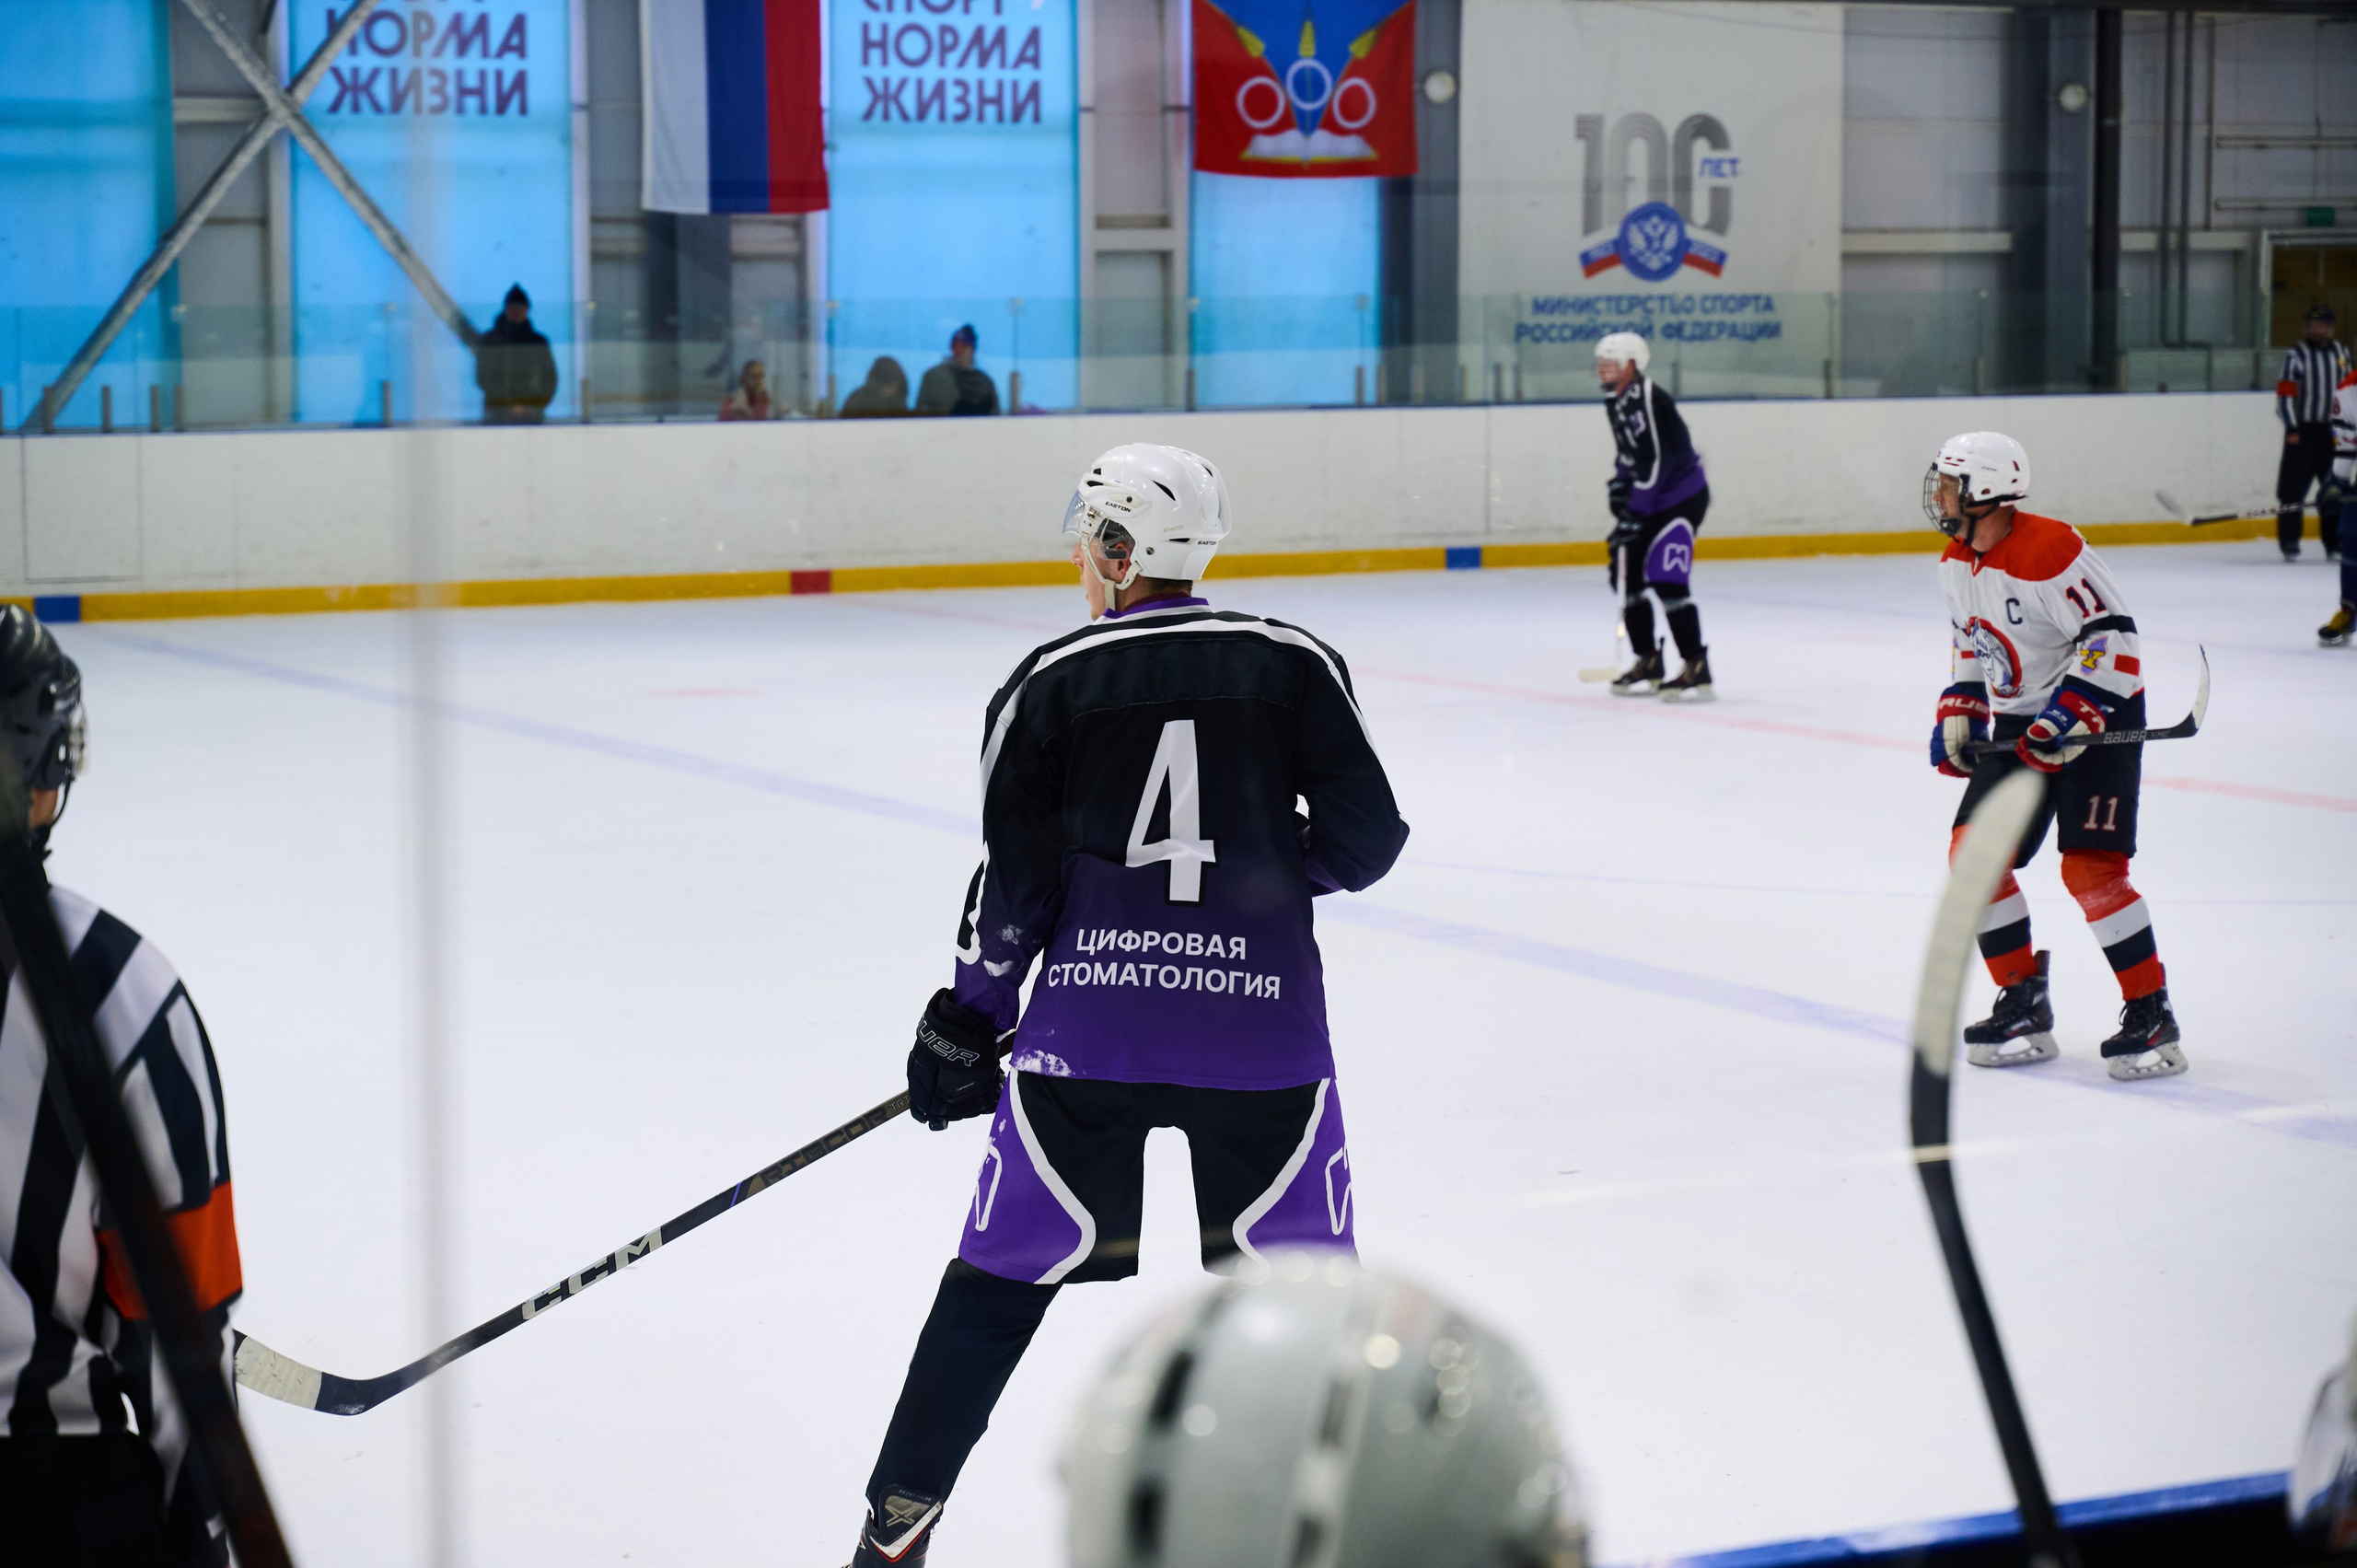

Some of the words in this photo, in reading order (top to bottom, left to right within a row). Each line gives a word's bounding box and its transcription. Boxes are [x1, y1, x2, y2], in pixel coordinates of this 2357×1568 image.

[860, 21, 1041, 71] НОРМА
[328, 66, 528, 117] ЖИЗНИ
[861, 76, 1041, 124] ЖИЗНИ
[1573, 110, 1732, 238] 100
[1698, 157, 1740, 179] ЛЕТ
[1531, 295, 1695, 316] МИНИСТЕРСТВО
[1700, 294, 1775, 315] СПОРТА
[1660, 320, 1782, 342] ФЕДЕРАЦИИ
[1105, 501, 1132, 513] EASTON
[2005, 598, 2024, 625] C
[2065, 577, 2107, 619] 11
[2103, 729, 2147, 744] BAUER
[1125, 719, 1217, 902] 4
[2083, 794, 2119, 831] 11
[1075, 928, 1247, 960] ЦИФРОВАЯ
[1048, 962, 1281, 1000] СТОМАТОЛОГИЯ
[918, 1014, 981, 1067] UER
[521, 1225, 663, 1321] CCM
